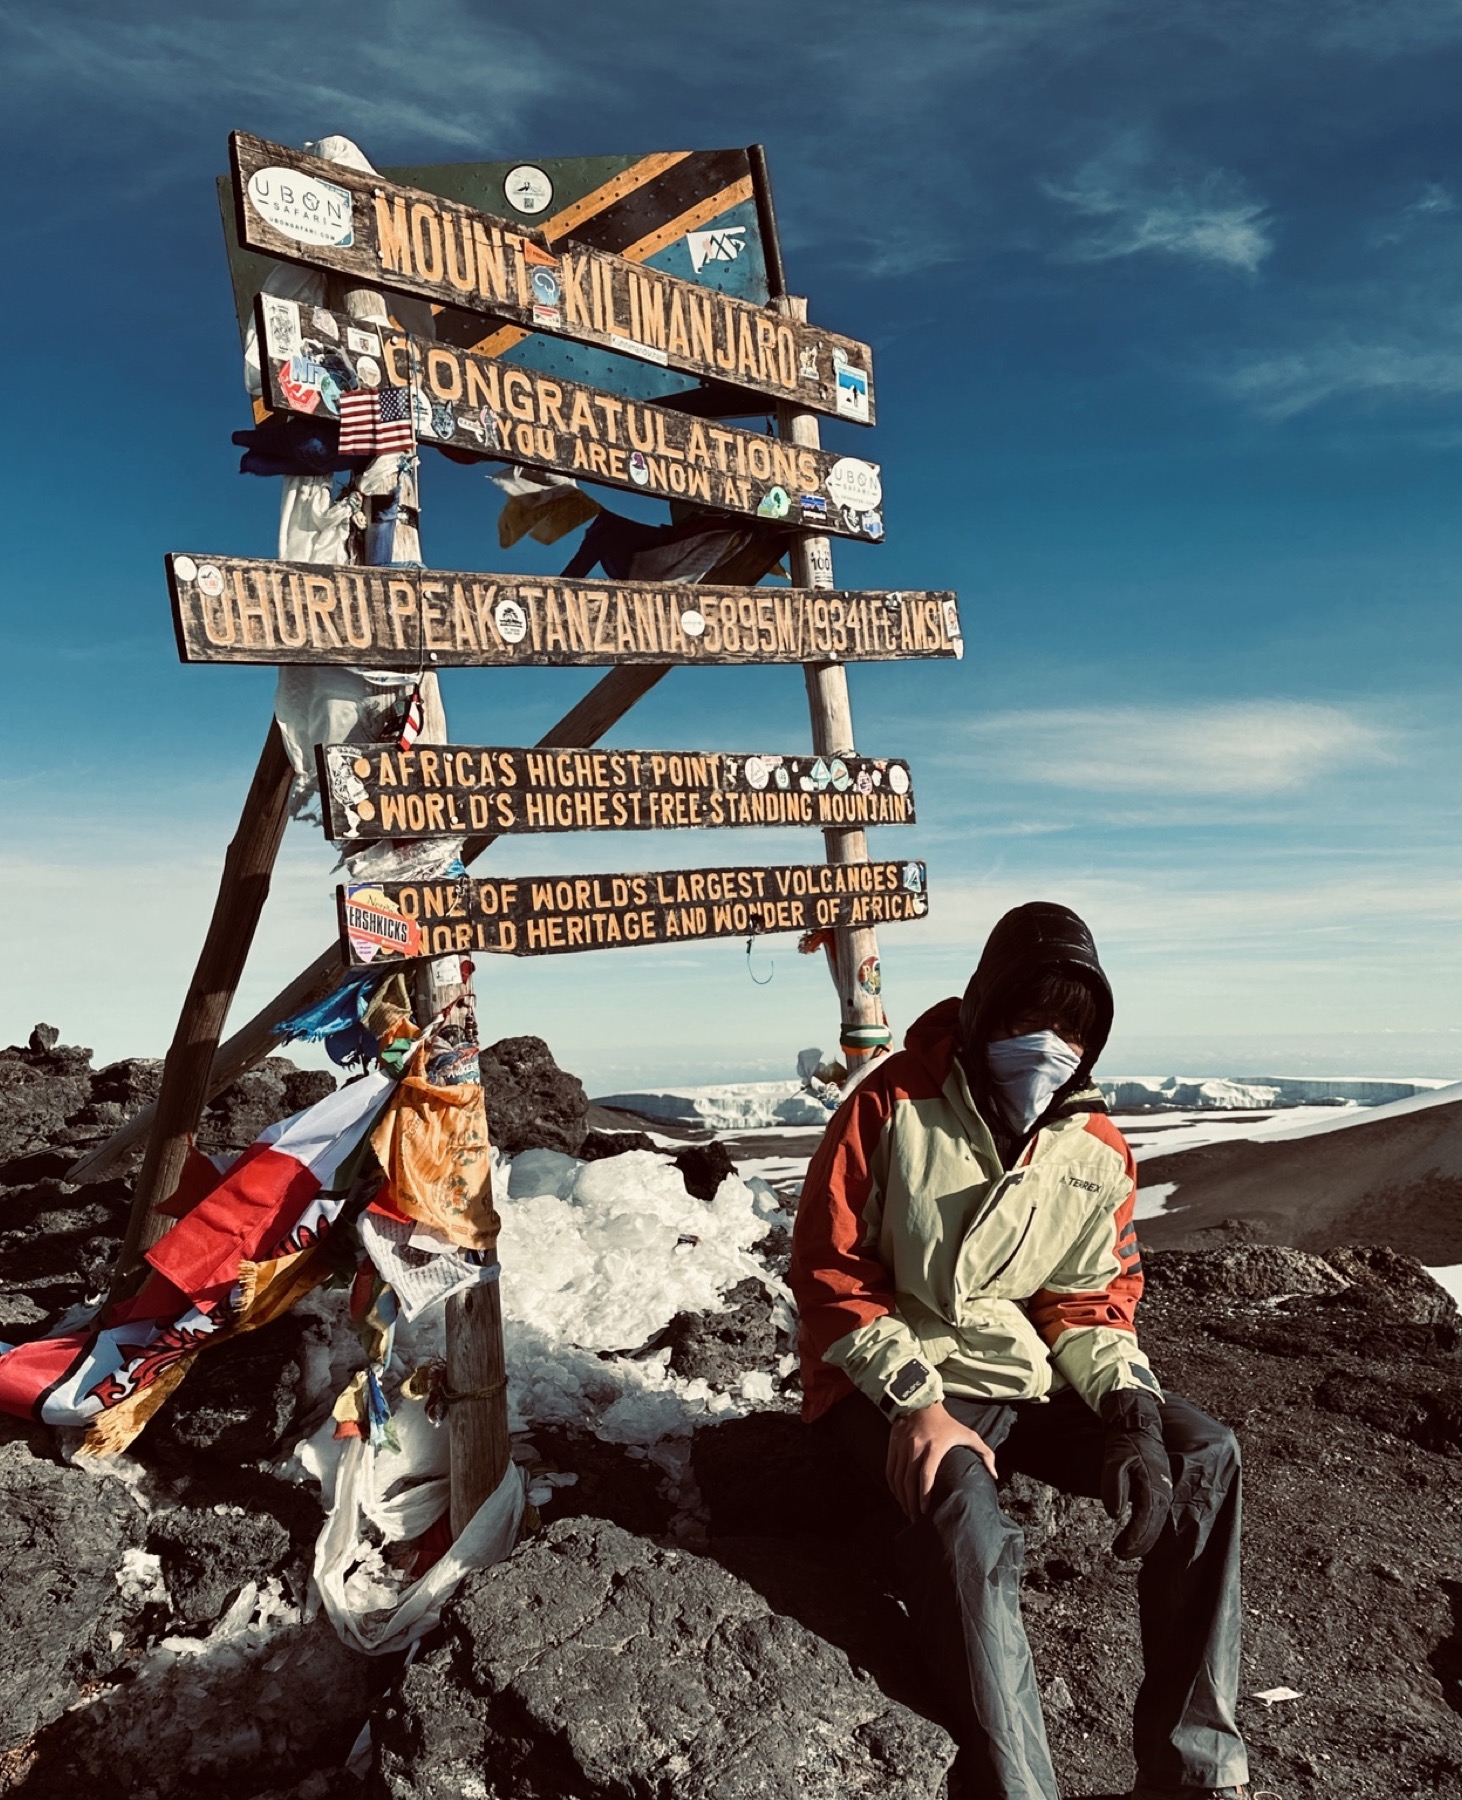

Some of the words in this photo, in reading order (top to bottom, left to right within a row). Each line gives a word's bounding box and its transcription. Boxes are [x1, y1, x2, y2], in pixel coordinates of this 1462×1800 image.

[255, 176, 342, 220] UBON
[273, 202, 326, 225] SAFARI
[375, 191, 530, 307] MOUNT
[562, 252, 797, 388] KILIMANJARO
[385, 338, 820, 492] CONGRATULATIONS
[498, 419, 556, 461] YOU
[573, 438, 628, 481] ARE
[649, 457, 711, 502] NOW
[724, 478, 752, 510] AT
[202, 570, 373, 648] UHURU
[901, 600, 955, 651] AMSL
[379, 750, 517, 787] AFRICA'S
[526, 753, 642, 788] HIGHEST
[653, 755, 721, 790] POINT
[380, 793, 518, 831] WORLD'S
[525, 791, 642, 828] HIGHEST
[818, 793, 908, 823] MOUNTAIN
[398, 885, 467, 919] ONE
[480, 884, 518, 915] OF
[532, 878, 648, 913] WORLD'S
[657, 871, 766, 905] LARGEST
[347, 904, 408, 943] ERSHKICKS
[528, 911, 657, 950] HERITAGE
[665, 907, 707, 937] AND
[816, 898, 841, 925] OF
[852, 895, 915, 921] AFRICA
